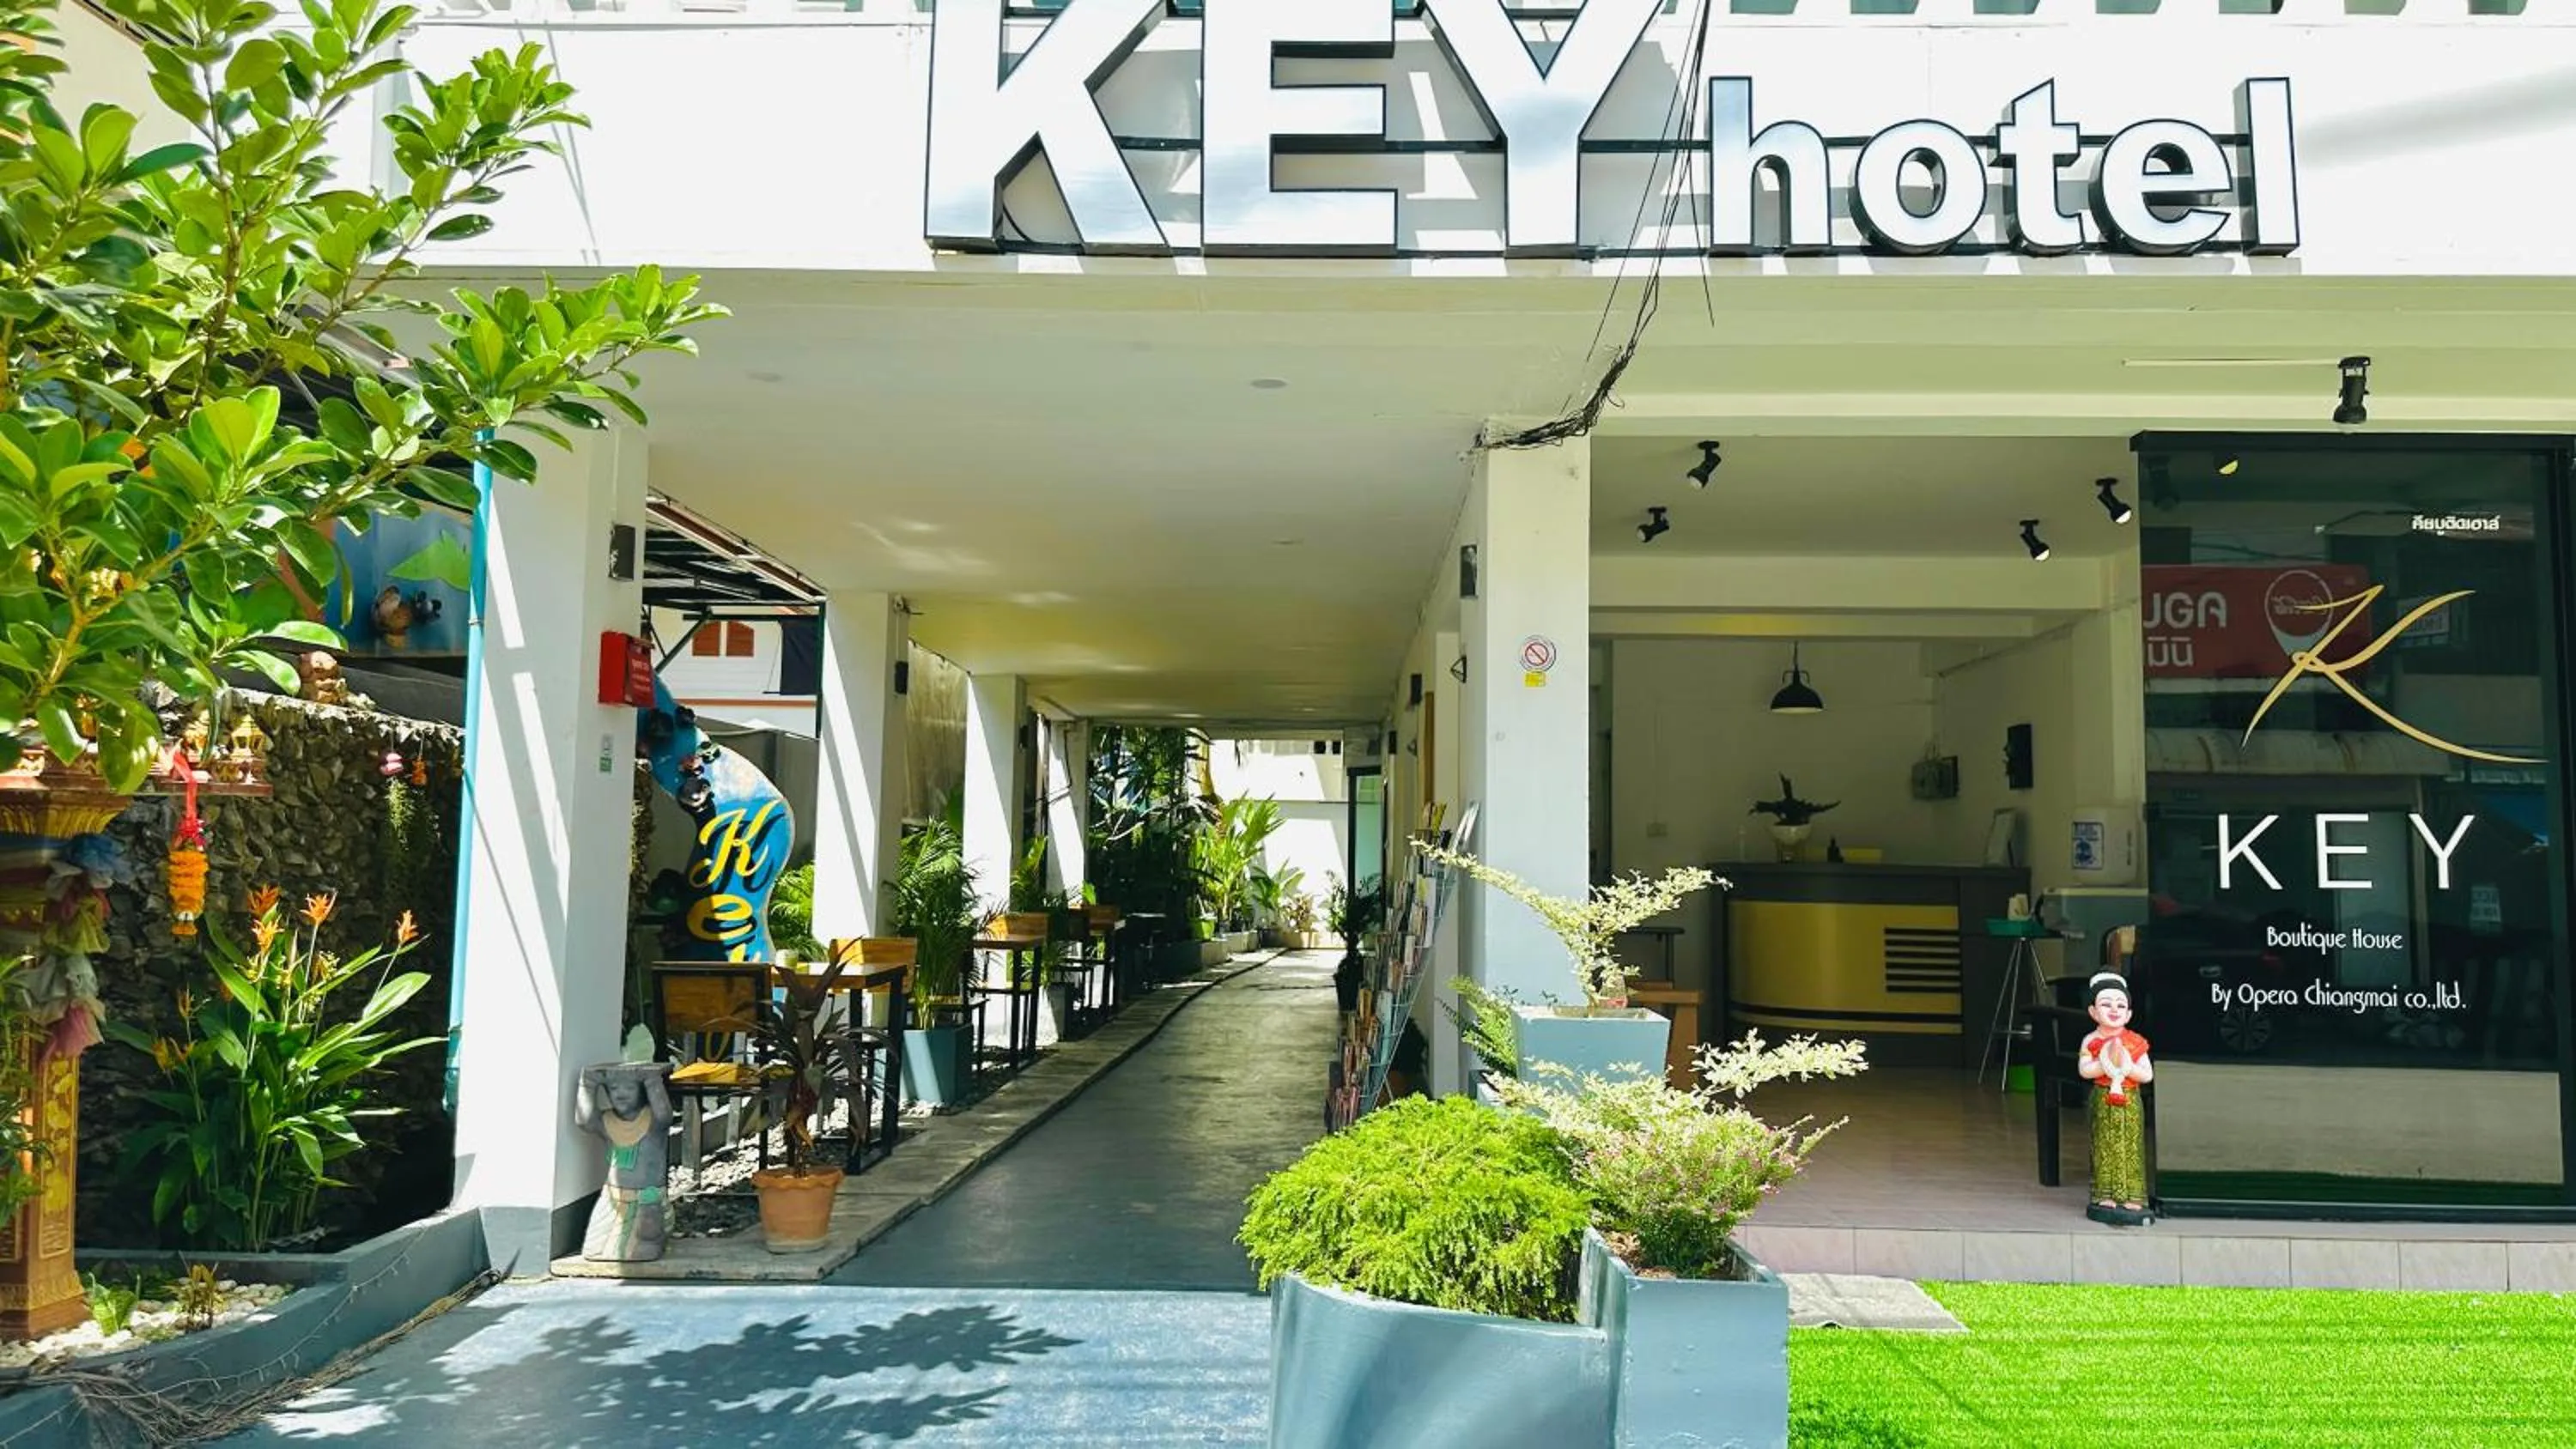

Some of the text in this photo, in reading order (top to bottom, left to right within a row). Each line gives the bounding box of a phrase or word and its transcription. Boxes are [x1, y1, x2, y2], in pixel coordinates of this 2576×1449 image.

[925, 0, 2300, 256] KEY hotel
[2218, 813, 2476, 890] KEY
[2267, 923, 2403, 955] Boutique House
[2211, 983, 2233, 1011] By
[2238, 985, 2299, 1012] Opera
[2305, 979, 2399, 1014] Chiangmai
